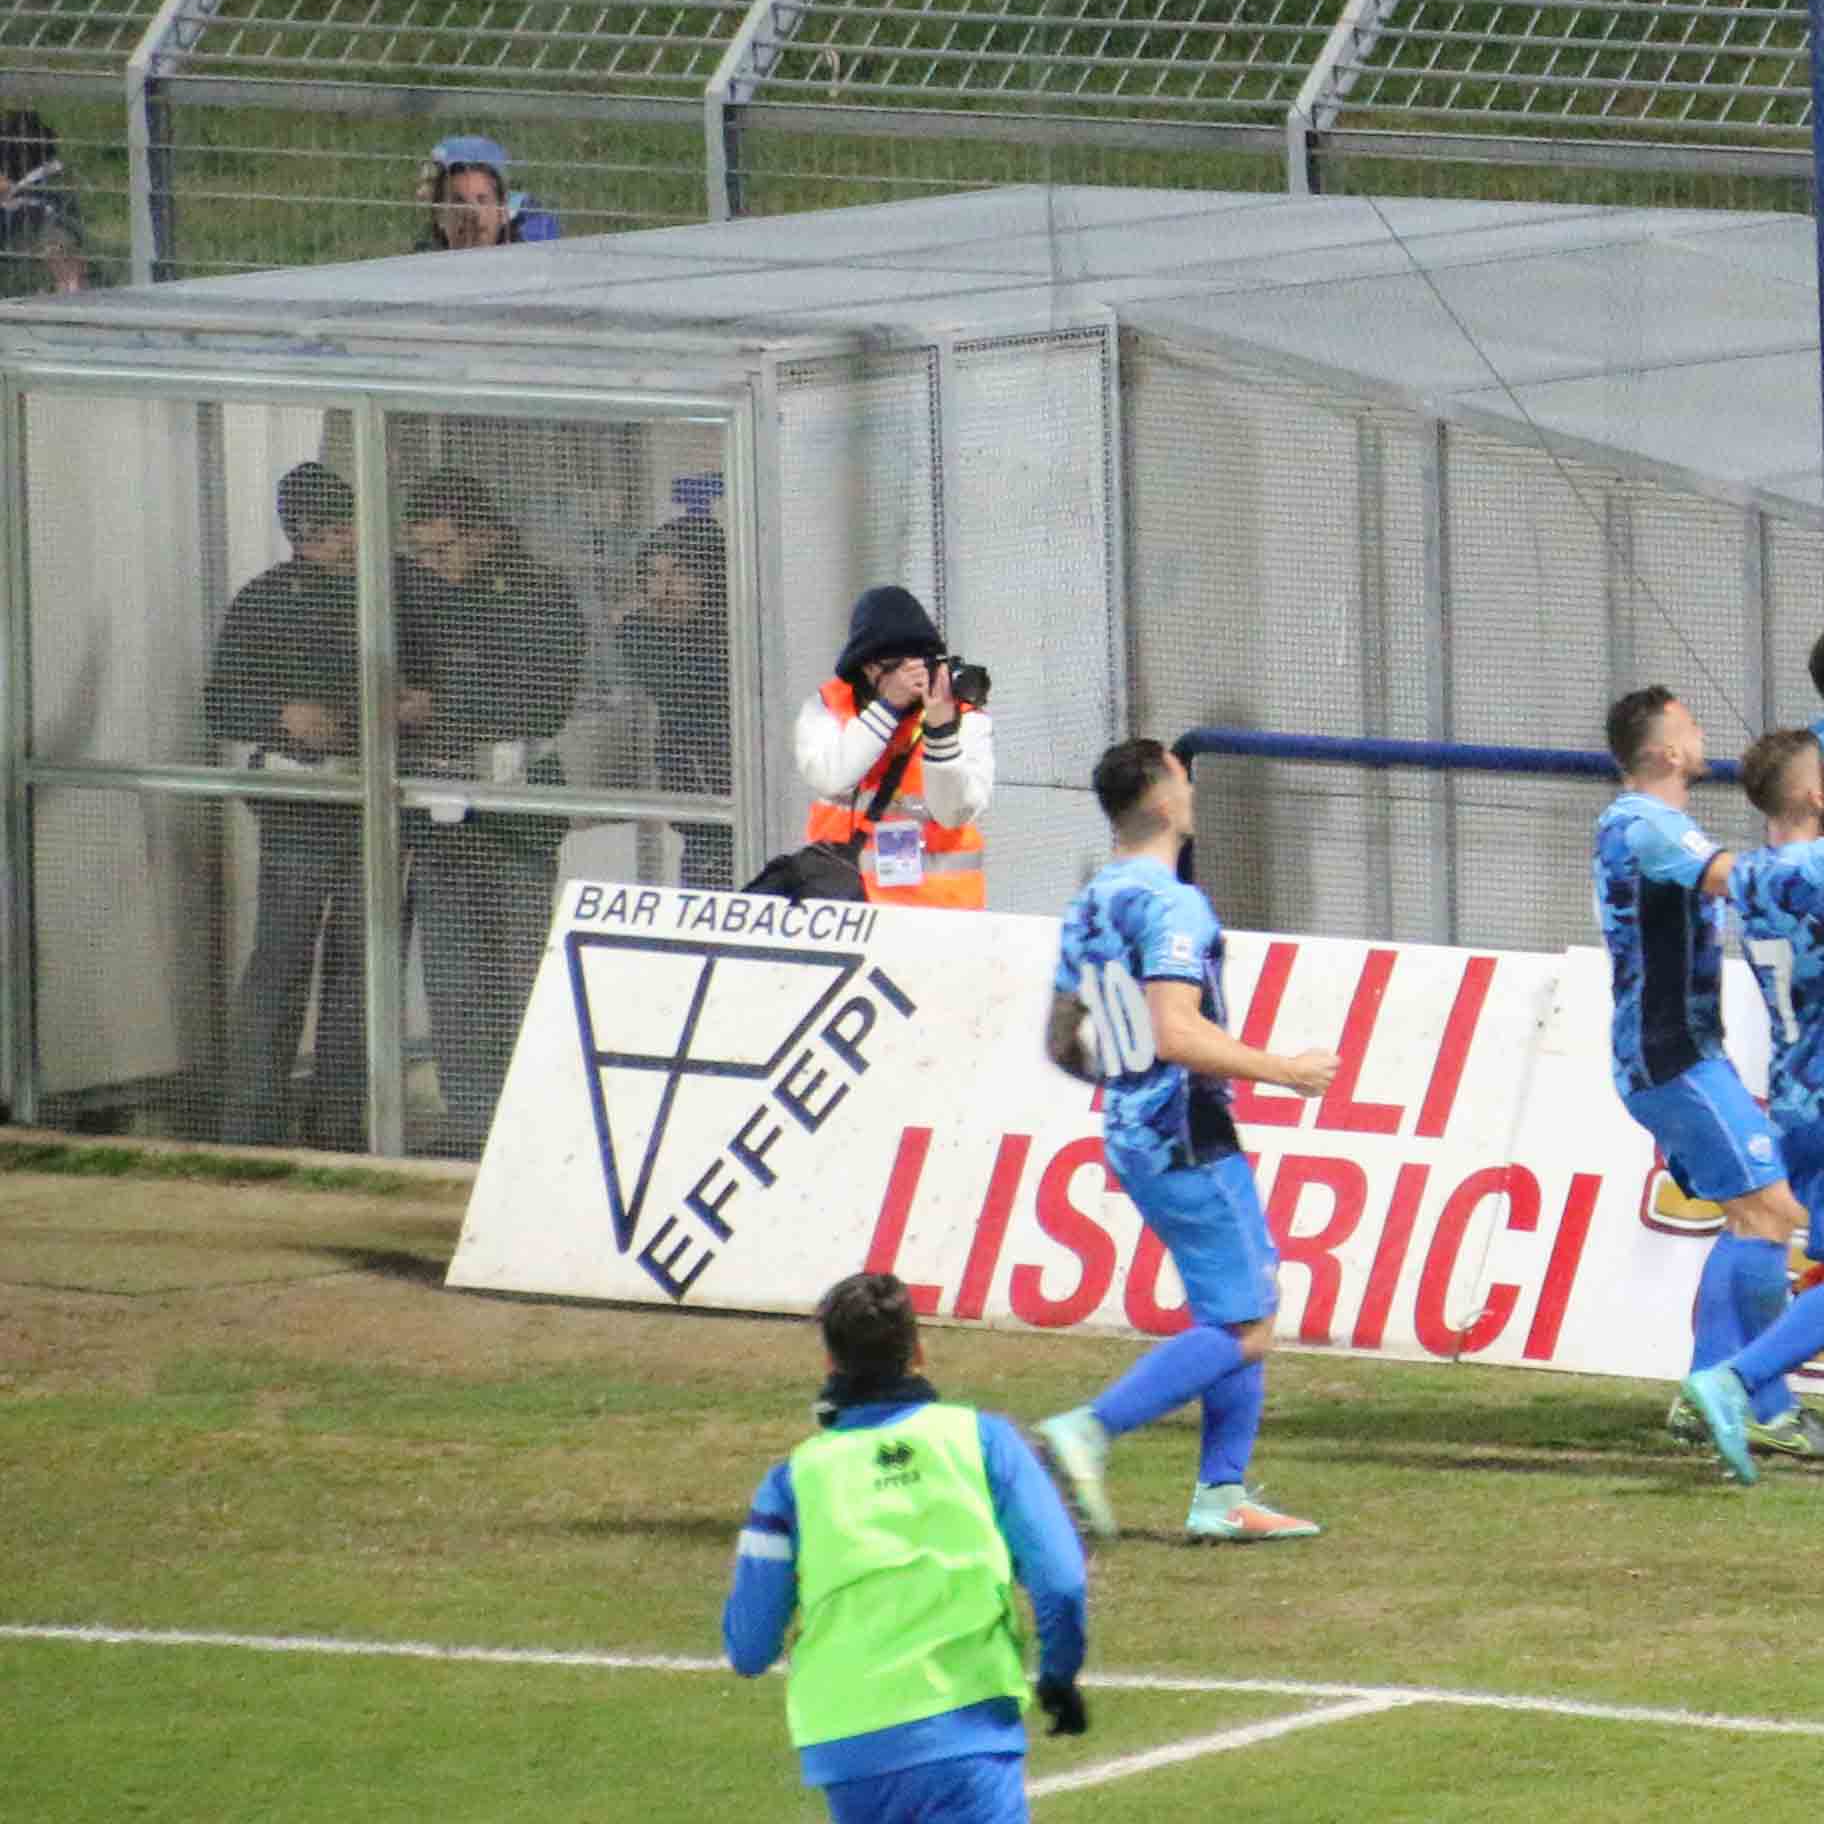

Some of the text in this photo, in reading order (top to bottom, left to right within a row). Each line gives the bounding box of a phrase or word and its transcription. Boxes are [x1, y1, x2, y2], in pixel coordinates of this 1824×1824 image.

[574, 885, 879, 945] BAR TABACCHI
[636, 966, 919, 1304] EFFEPI
